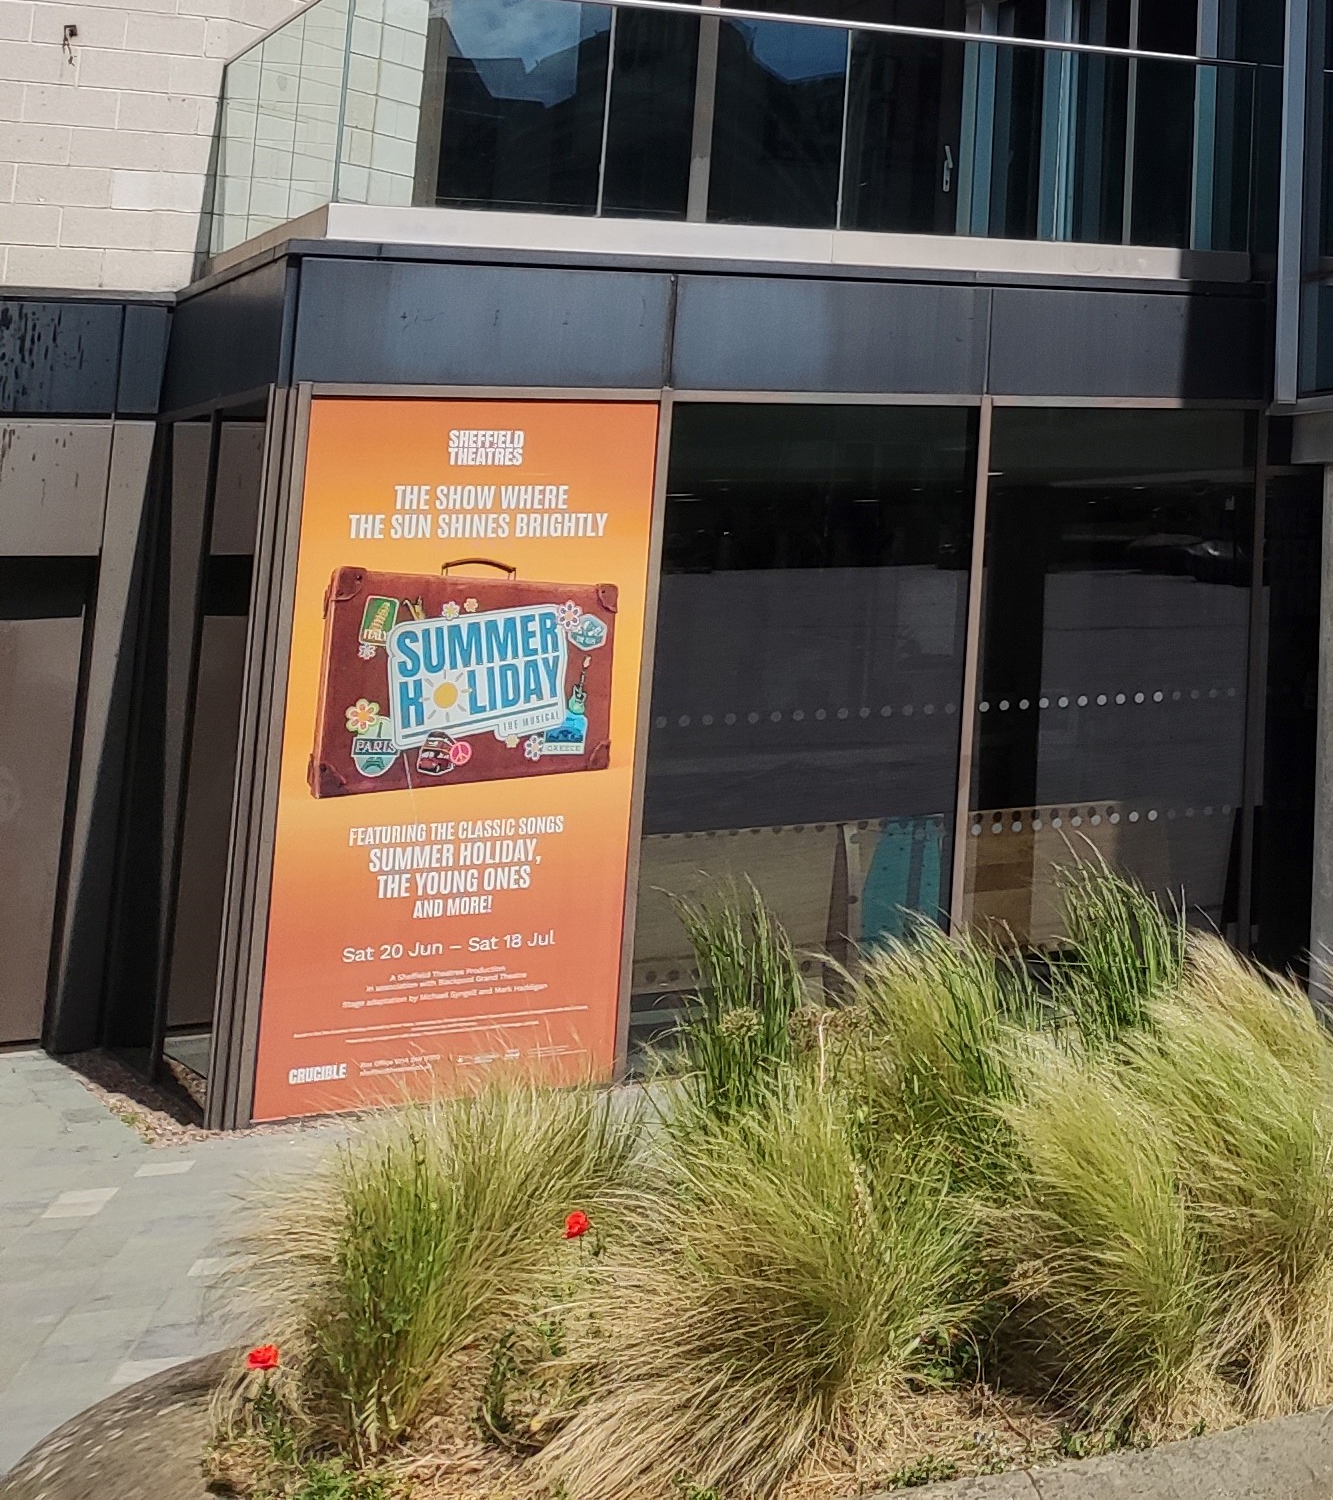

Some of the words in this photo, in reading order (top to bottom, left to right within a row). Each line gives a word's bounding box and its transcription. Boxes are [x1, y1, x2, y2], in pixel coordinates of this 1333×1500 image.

[448, 447, 523, 466] THEATRES
[394, 485, 431, 510] THE
[435, 485, 496, 510] SHOW
[501, 485, 569, 509] WHERE
[349, 514, 385, 539] THE
[390, 514, 432, 539] SUN
[437, 513, 510, 538] SHINES
[515, 512, 608, 537] BRIGHTLY
[396, 611, 560, 678] SUMMER
[522, 713, 559, 728] MUSICAL
[355, 740, 397, 753] PARIS
[349, 823, 426, 846] FEATURING
[430, 822, 455, 841] THE
[458, 818, 516, 839] CLASSIC
[518, 815, 565, 835] SONGS
[368, 843, 454, 872] SUMMER
[459, 838, 542, 866] HOLIDAY,
[376, 873, 412, 899] THE
[415, 869, 478, 896] YOUNG
[483, 865, 531, 891] ONES
[412, 899, 443, 919] AND
[446, 895, 493, 916] MORE!
[341, 946, 375, 963] Sat
[379, 943, 403, 960] 20
[408, 941, 443, 957] Jun
[467, 936, 500, 952] Sat
[503, 933, 522, 949] 18
[527, 929, 556, 947] Jul
